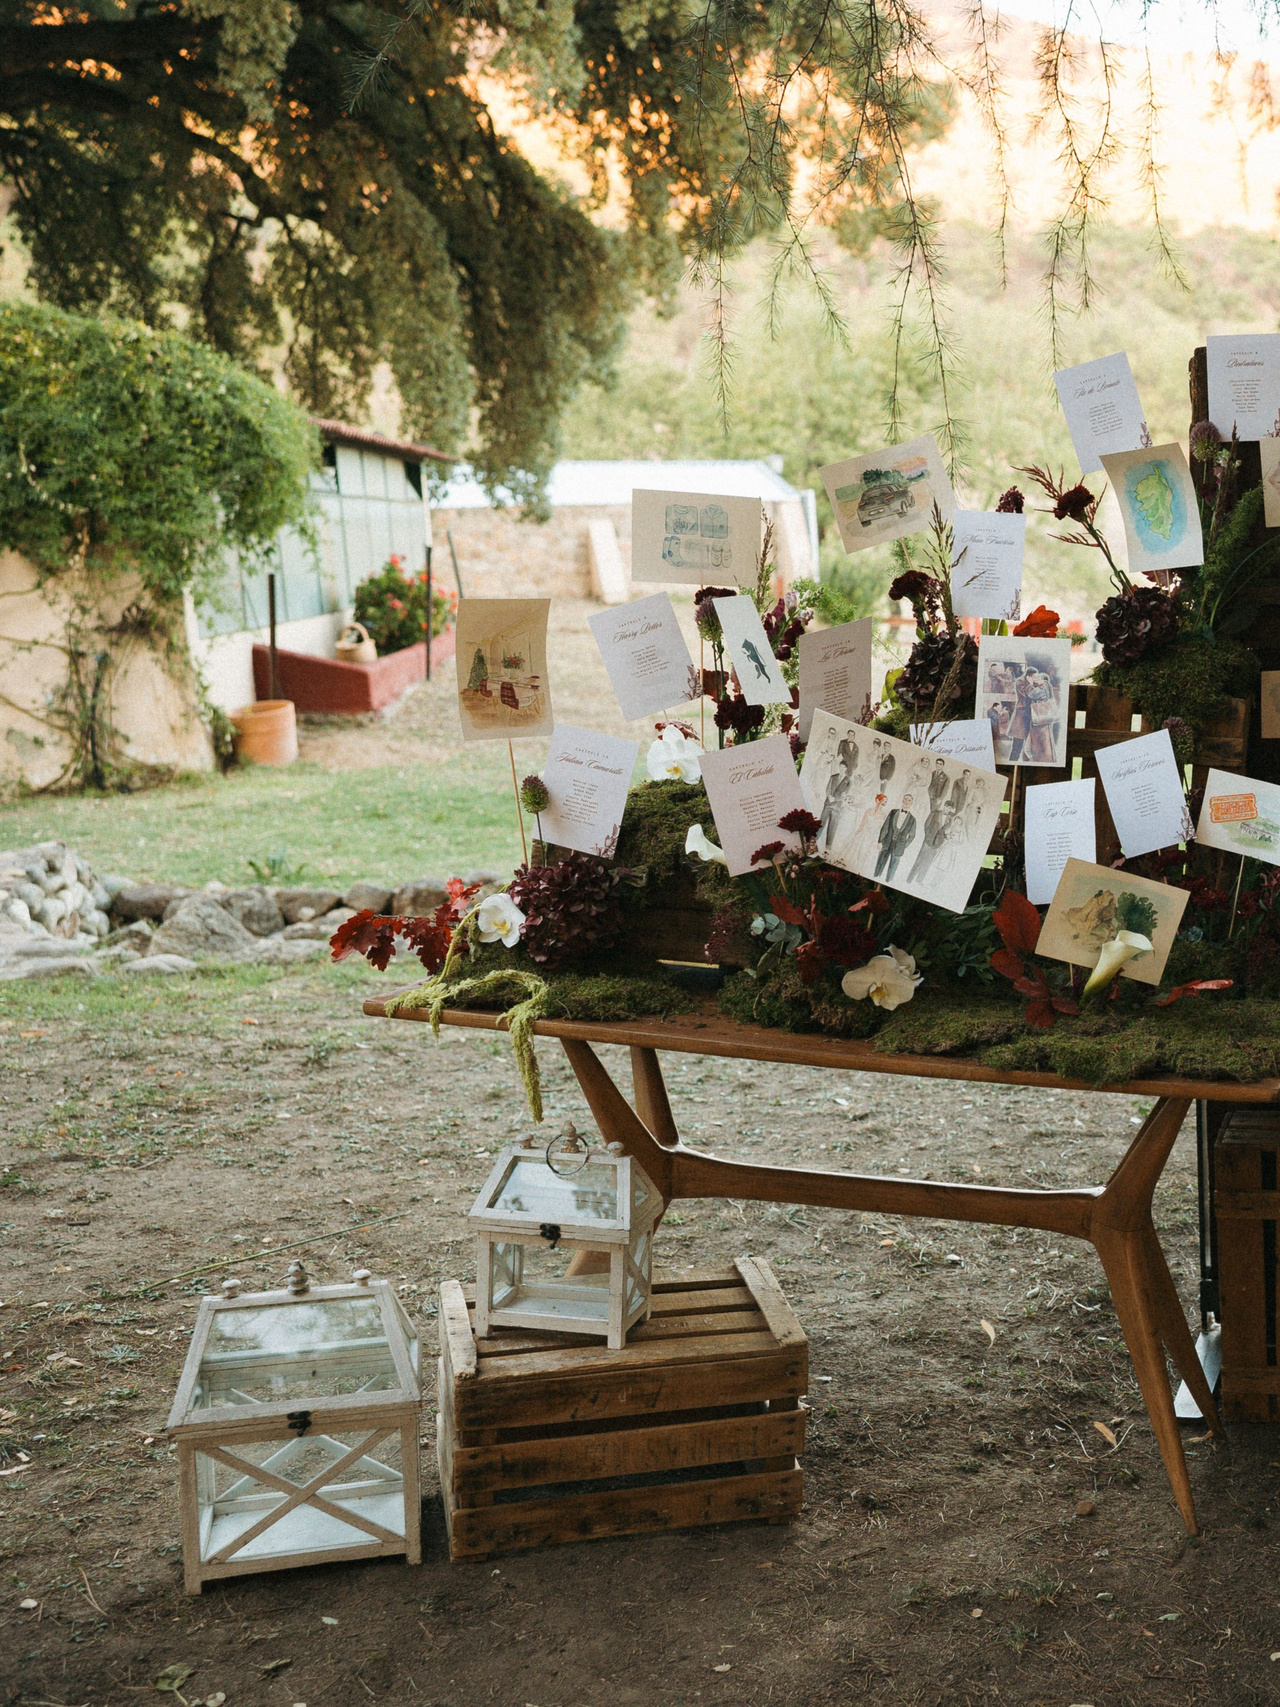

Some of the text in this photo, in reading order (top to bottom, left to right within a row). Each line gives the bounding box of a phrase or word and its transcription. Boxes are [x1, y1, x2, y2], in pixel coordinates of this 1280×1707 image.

[613, 622, 663, 644] Harry Potter
[955, 744, 988, 754] Disaster
[1138, 759, 1165, 773] Forever
[729, 771, 744, 785] El
[1044, 808, 1059, 820] Cap
